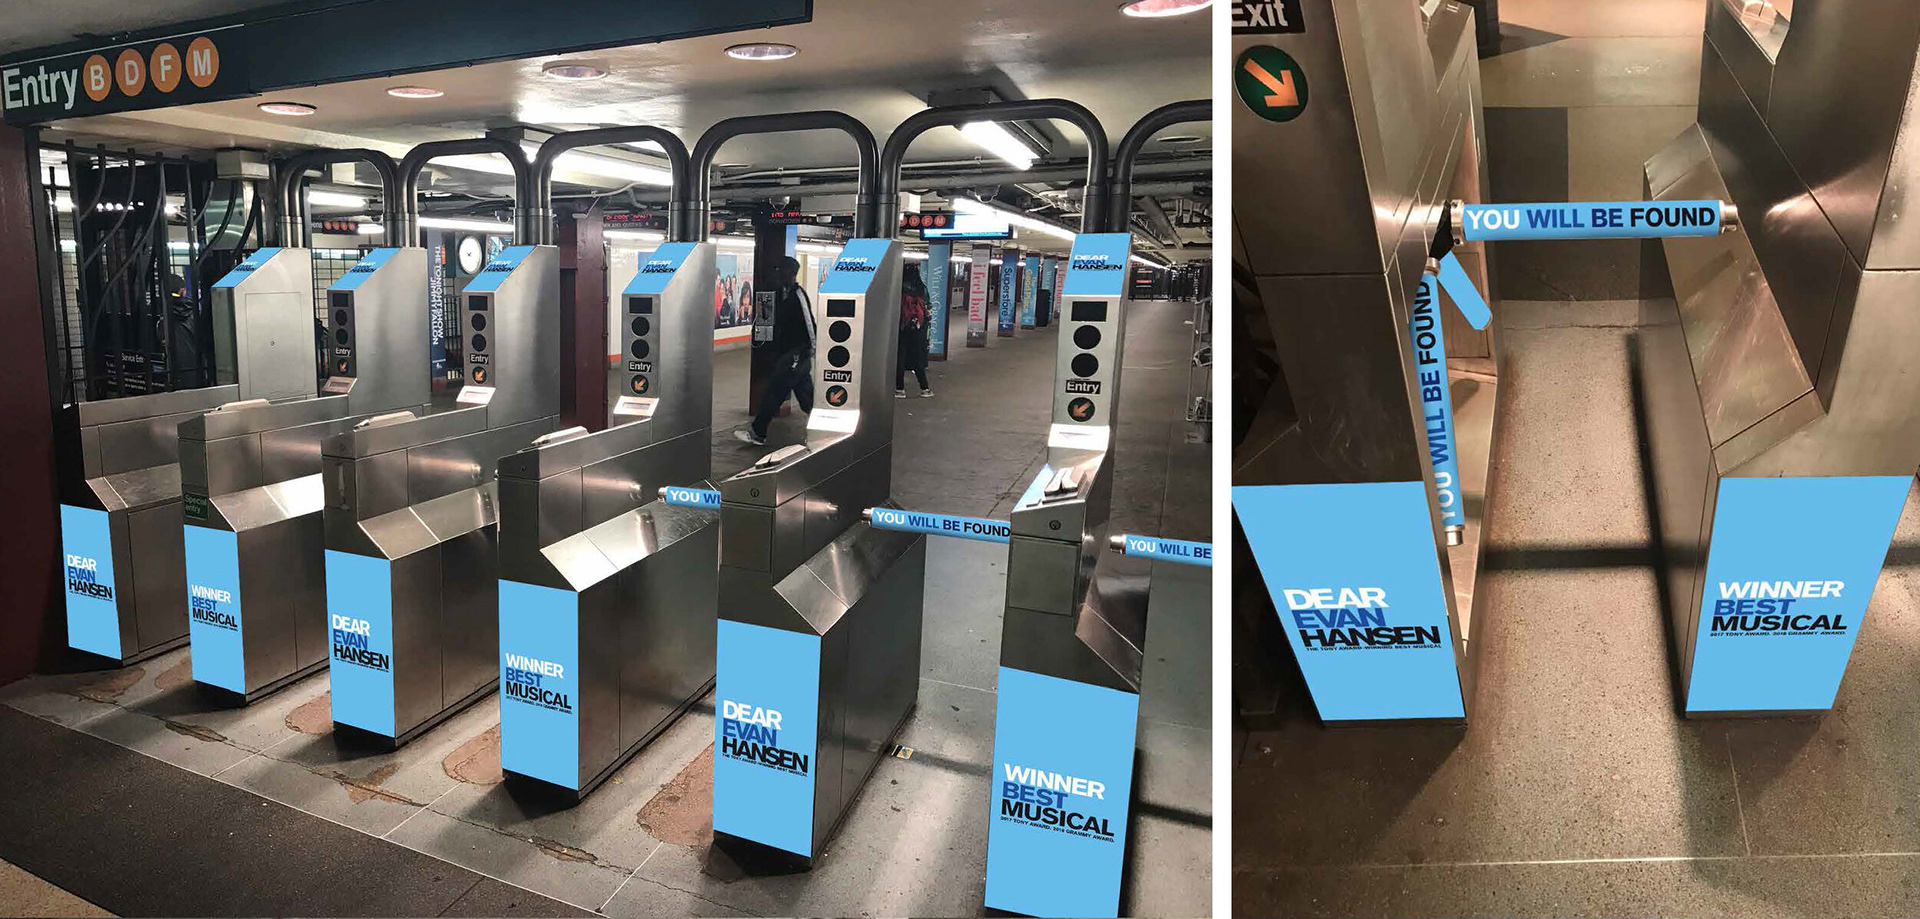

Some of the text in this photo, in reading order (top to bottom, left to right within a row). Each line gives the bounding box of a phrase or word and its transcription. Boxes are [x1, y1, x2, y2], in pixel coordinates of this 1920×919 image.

[3, 49, 211, 110] Entry B D F M
[1467, 207, 1715, 229] YOU WILL BE FOUND
[1001, 267, 1013, 317] Superstore
[970, 298, 985, 322] bad
[335, 347, 351, 356] Entry
[470, 354, 488, 363] Entry
[629, 361, 651, 373] Entry
[824, 370, 851, 383] Entry
[1066, 381, 1100, 395] Entry
[1415, 280, 1456, 522] YOU WILL BE FOUND
[669, 490, 720, 504] YOU WI
[875, 511, 1010, 537] YOU WILL BE FOUND
[1129, 539, 1212, 559] YOU WILL BE
[67, 554, 97, 571] DEAR
[68, 566, 96, 583] EVAN
[68, 578, 112, 599] HANSEN
[191, 584, 231, 604] WINNER
[1283, 587, 1390, 610] DEAR
[1718, 580, 1845, 598] WINNER
[192, 596, 217, 611] BEST
[1714, 599, 1796, 615] BEST
[192, 607, 238, 628] MUSICAL
[332, 614, 370, 637] DEAR
[1291, 607, 1386, 629] EVAN
[1711, 614, 1848, 631] MUSICAL
[333, 628, 368, 650] EVAN
[1298, 626, 1441, 647] HANSEN
[333, 643, 389, 670] HANSEN
[505, 653, 564, 679] WINNER
[505, 667, 542, 687] BEST
[505, 681, 572, 710] MUSICAL
[723, 699, 782, 730] DEAR
[723, 718, 777, 747] EVAN
[722, 736, 808, 773] HANSEN
[1004, 763, 1106, 800] WINNER
[1002, 781, 1068, 809] BEST
[1001, 798, 1115, 836] MUSICAL
[1066, 829, 1092, 838] GRAMMY
